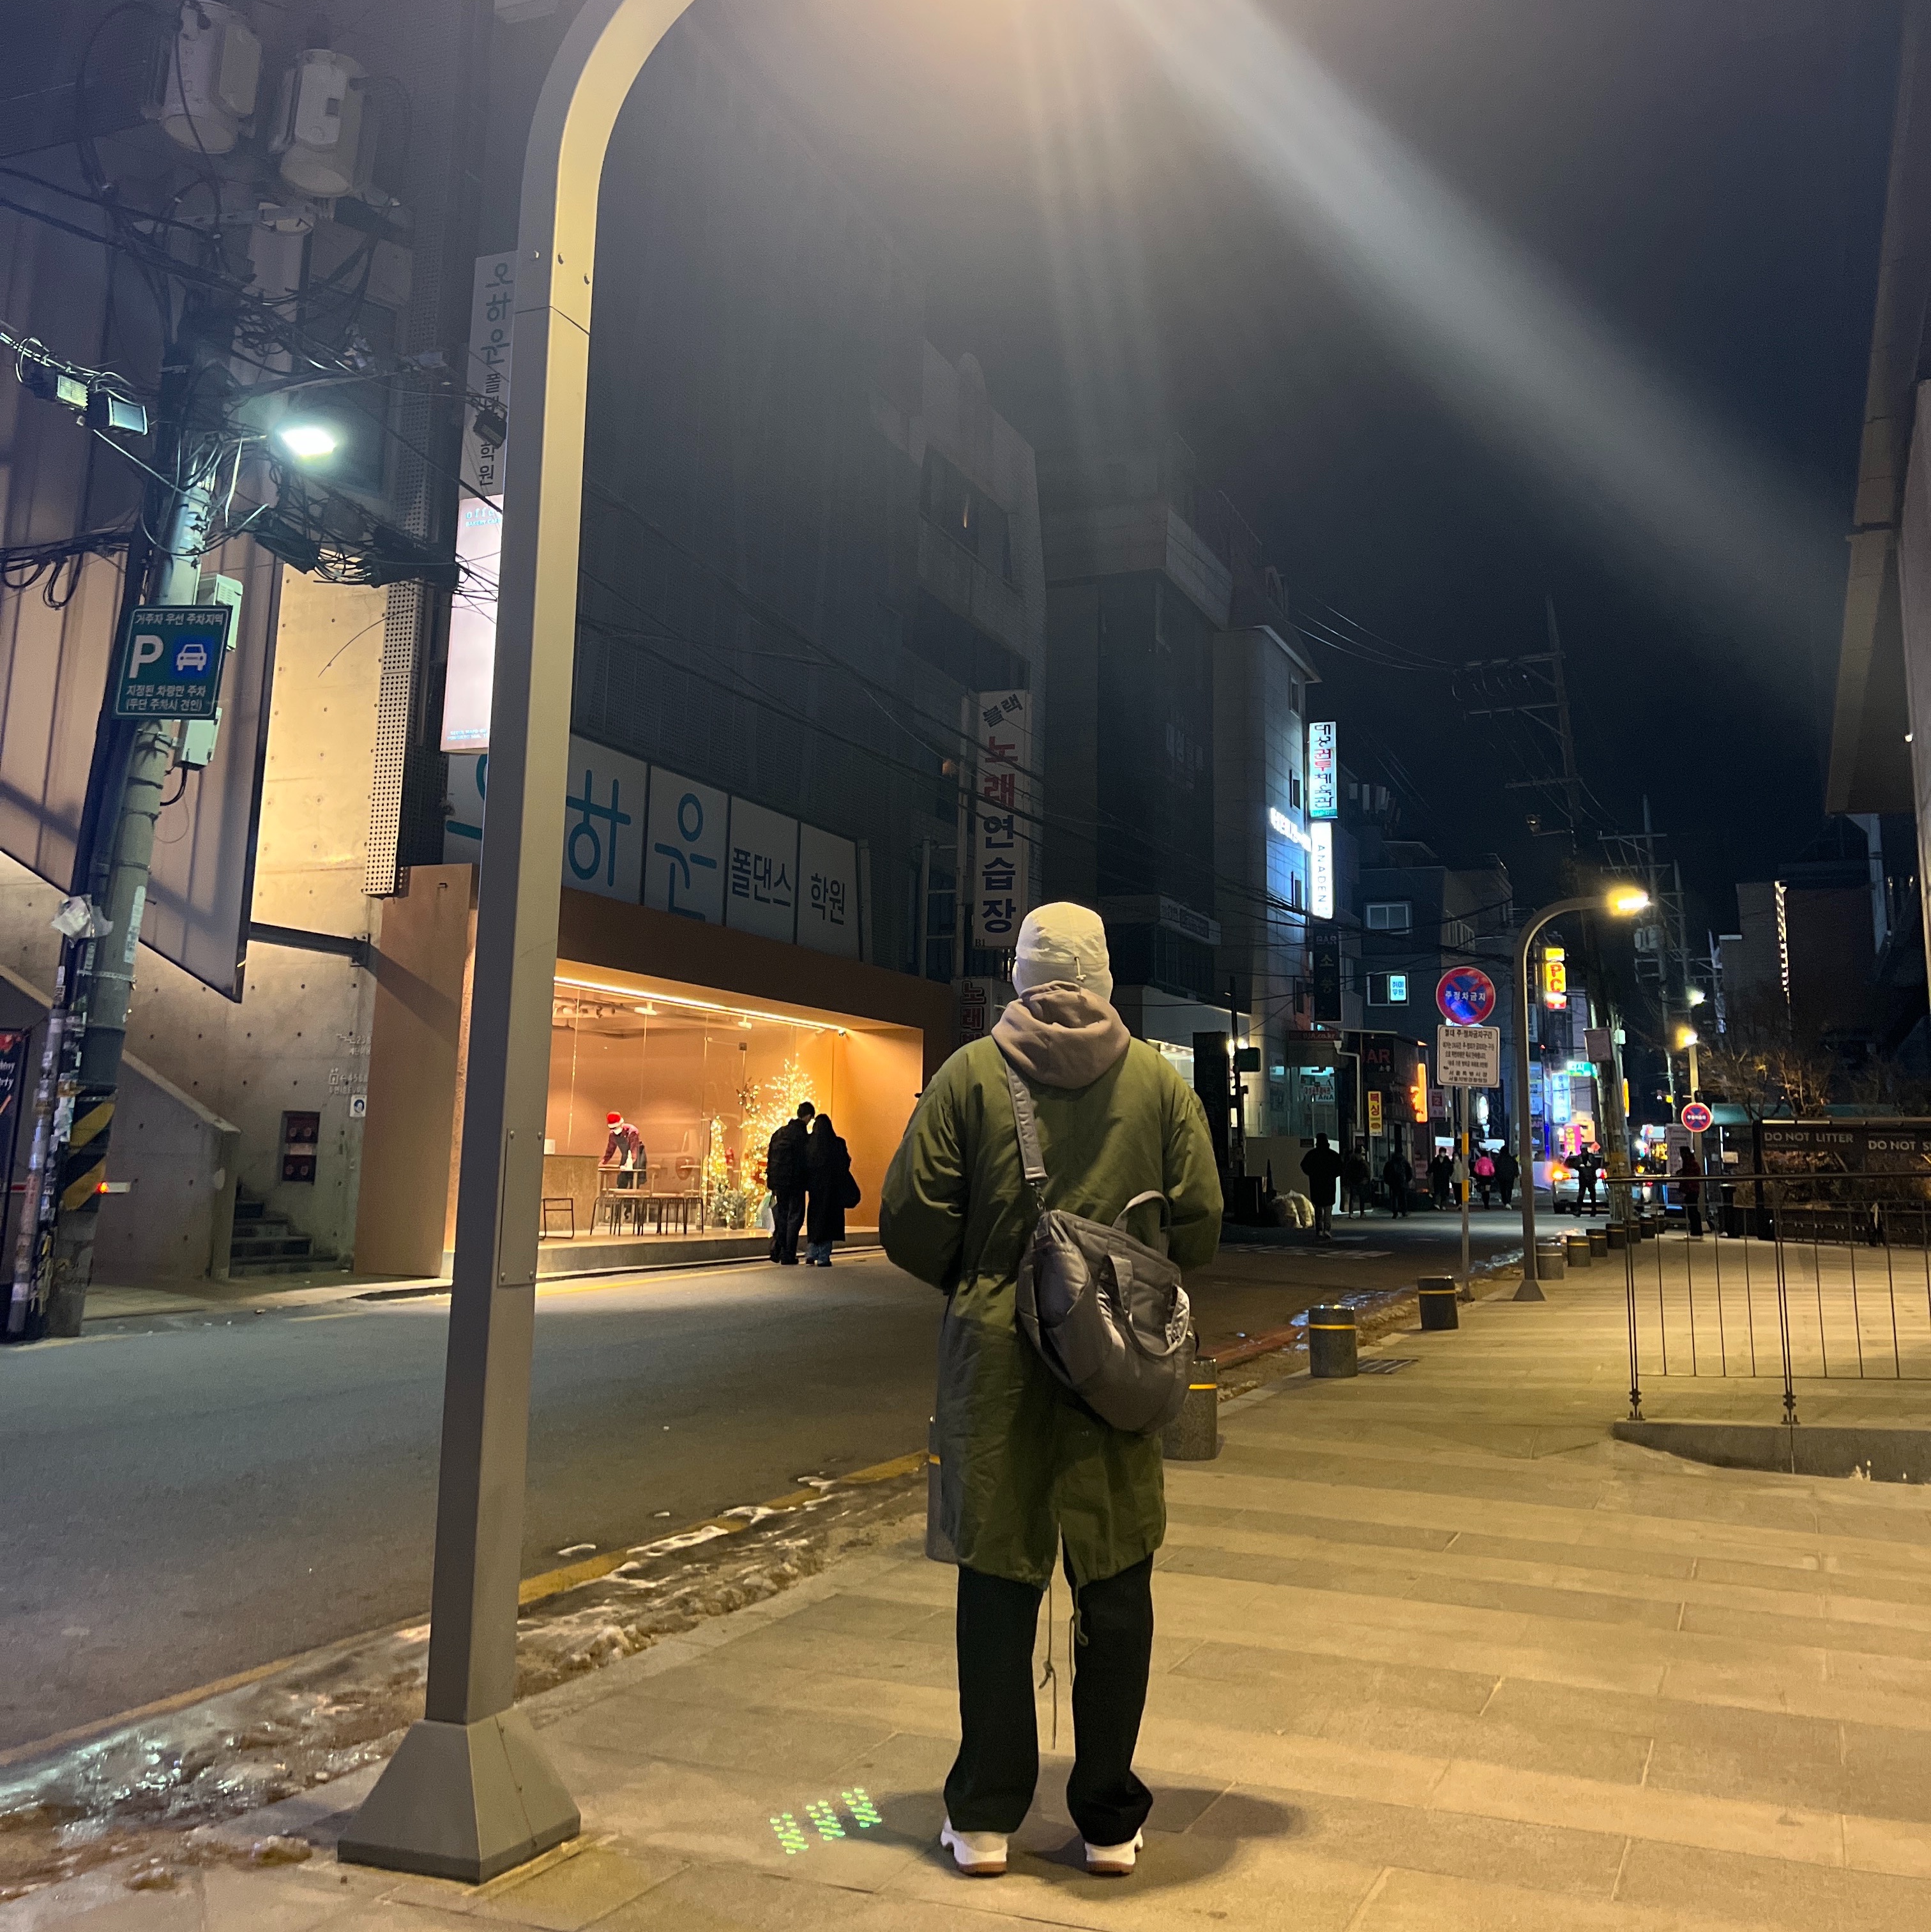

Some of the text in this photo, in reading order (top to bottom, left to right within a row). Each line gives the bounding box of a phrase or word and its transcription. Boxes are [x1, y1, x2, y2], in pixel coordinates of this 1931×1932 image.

[135, 613, 224, 626] 거주자 우선 주차지역
[129, 635, 164, 679] P
[126, 685, 206, 697] 지정된 차량만 주차
[126, 699, 202, 711] (무단 주차시 견인)
[983, 694, 1024, 727] 블랙
[982, 736, 1019, 933] 노래연습장
[732, 847, 791, 908] 폴댄스
[810, 872, 845, 925] 학원
[1550, 964, 1563, 993] PC
[1445, 991, 1487, 1001] 주정차금지
[1764, 1132, 1854, 1143] DO NOT LITTER
[1868, 1140, 1931, 1151] DO NOT S
